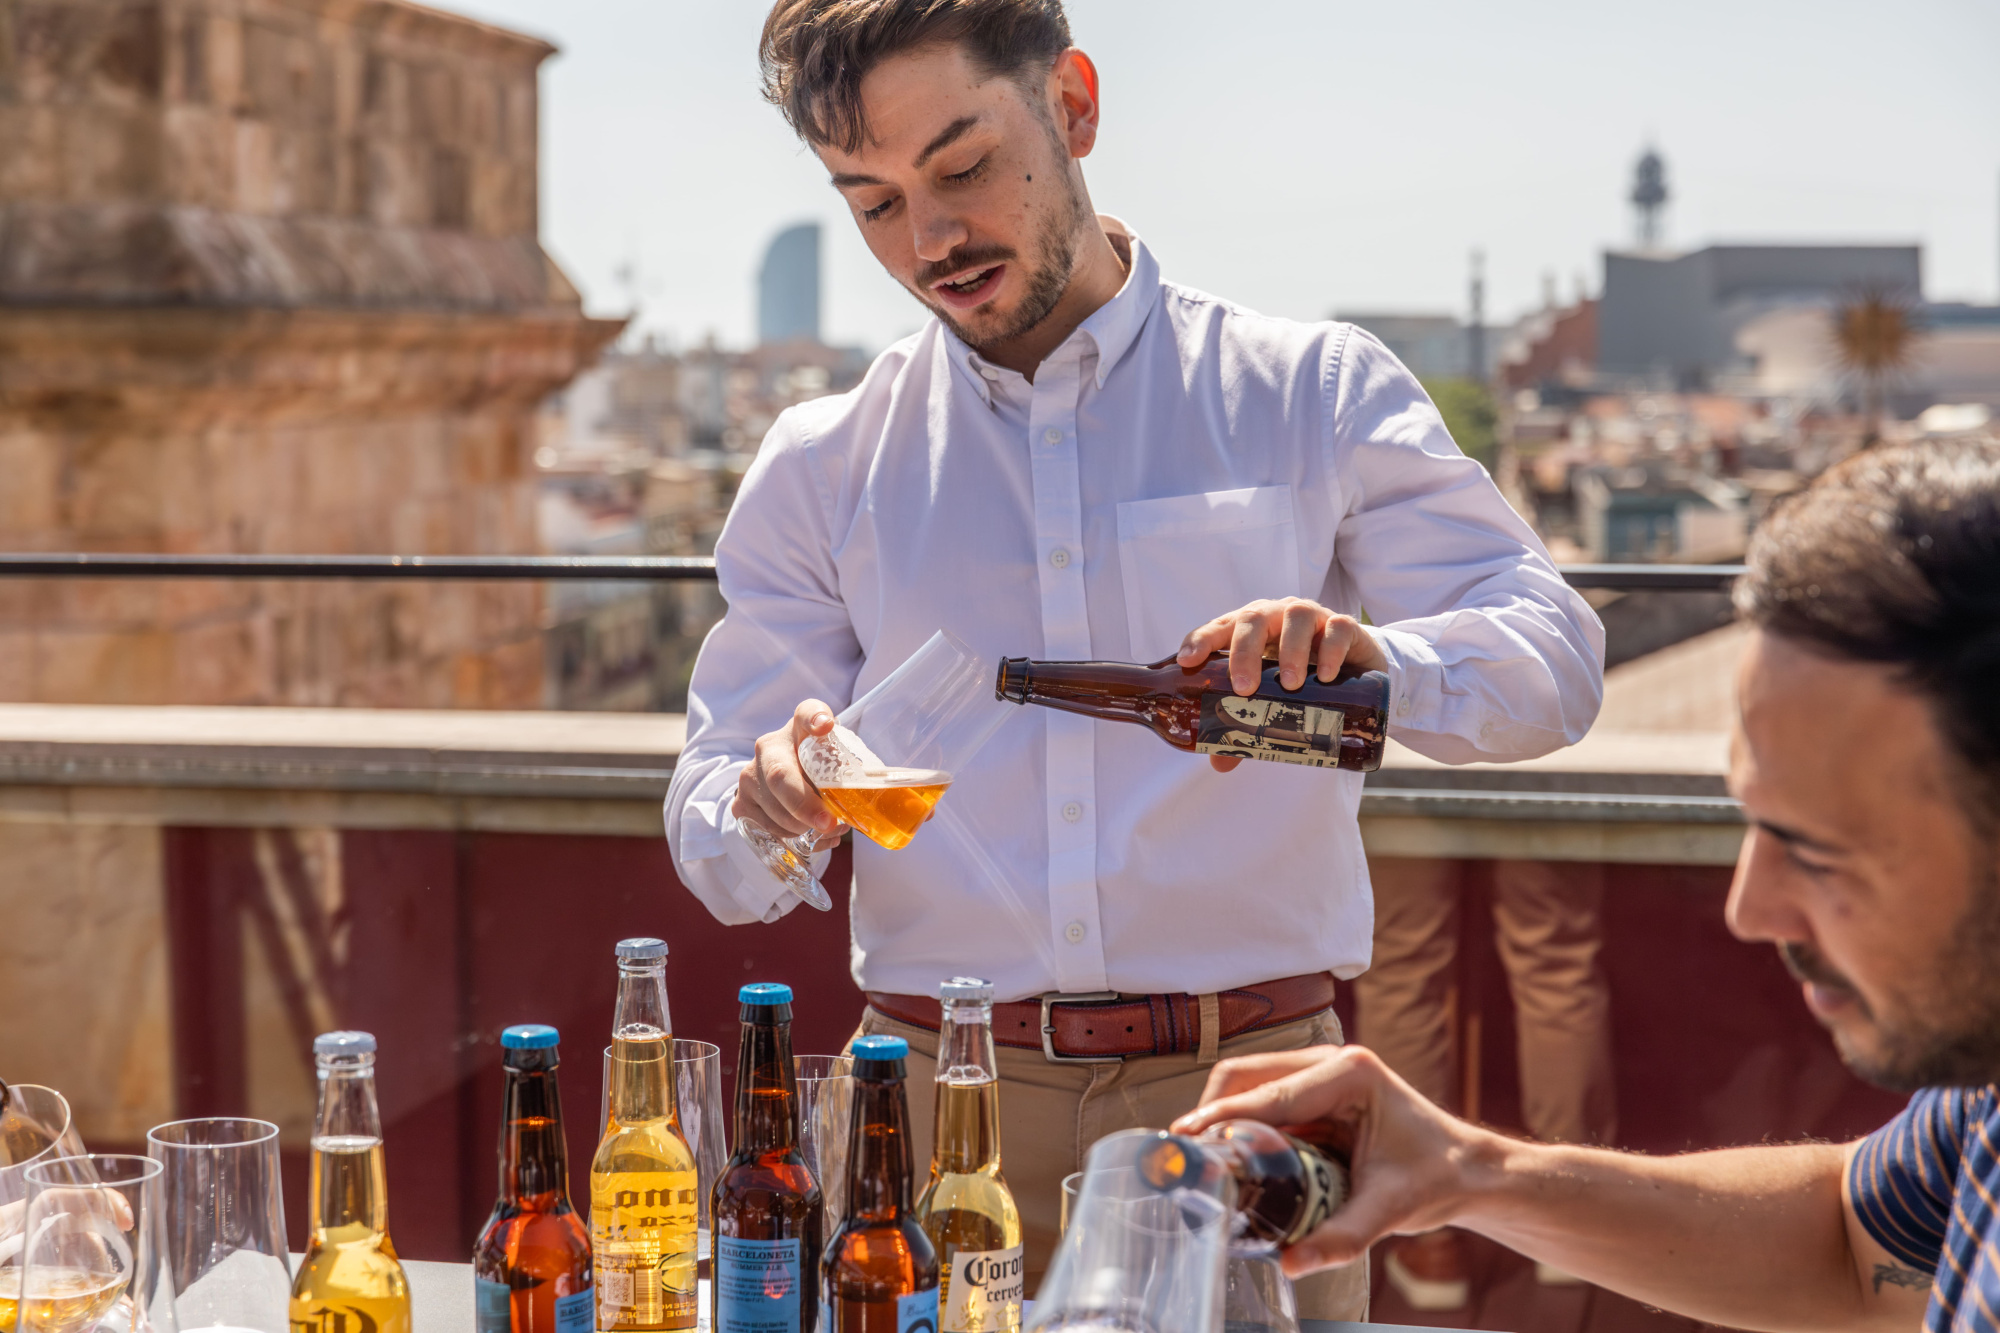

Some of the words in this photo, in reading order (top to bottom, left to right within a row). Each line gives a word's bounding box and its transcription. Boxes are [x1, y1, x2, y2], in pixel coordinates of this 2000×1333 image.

[721, 1246, 795, 1260] BARCELONETA
[730, 1262, 764, 1272] SUMMER
[766, 1262, 782, 1271] ALE
